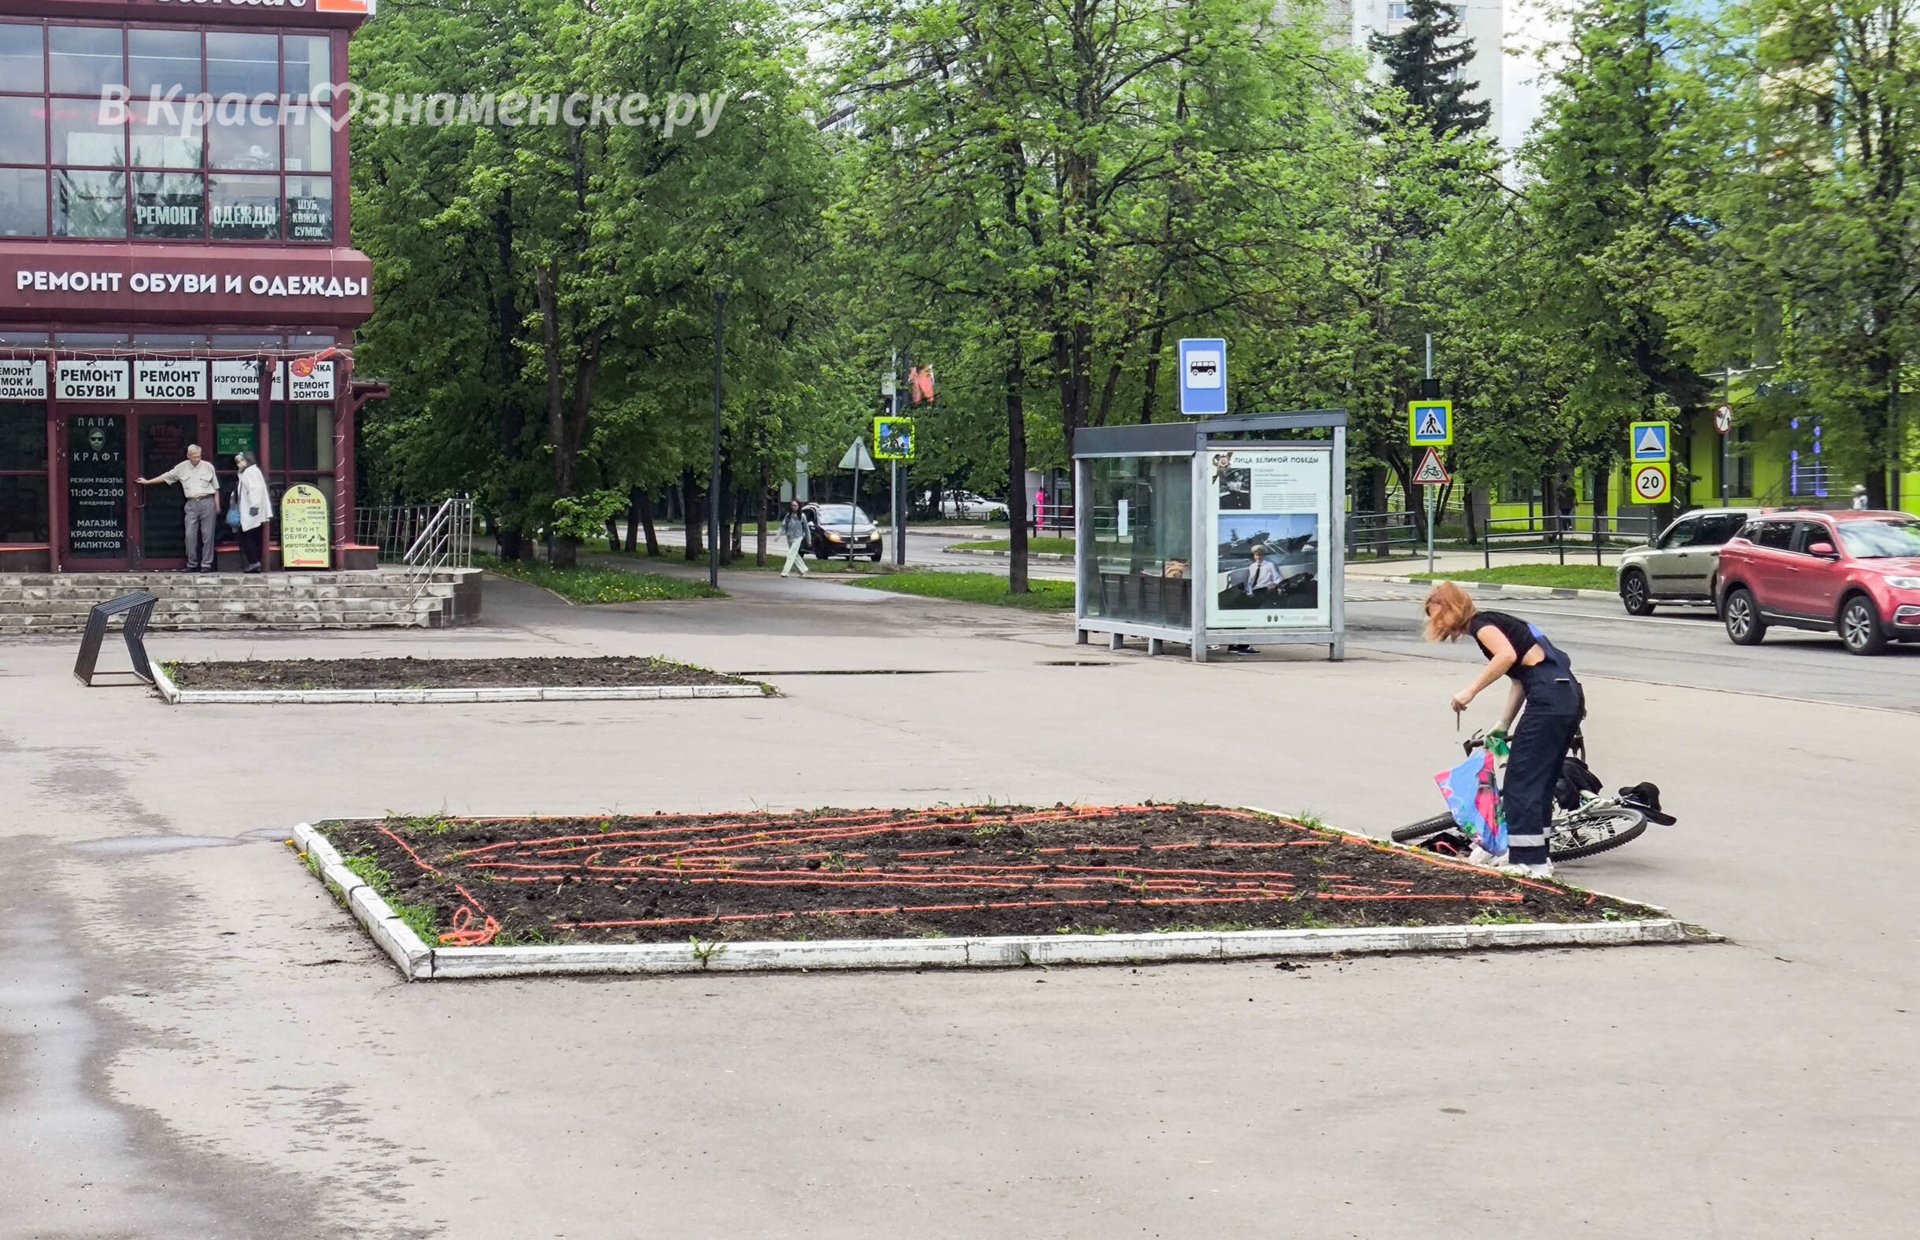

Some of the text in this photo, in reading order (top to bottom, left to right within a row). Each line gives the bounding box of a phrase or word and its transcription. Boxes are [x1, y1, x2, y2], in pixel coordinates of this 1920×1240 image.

[136, 205, 276, 228] РЕМОНТ ОДЕЖДЫ
[292, 213, 325, 224] КОЖИ И
[294, 226, 323, 237] СУМОК
[17, 270, 368, 298] РЕМОНТ ОБУВИ И ОДЕЖДЫ
[0, 367, 31, 376] МОНТ
[60, 369, 123, 382] РЕМОНТ
[140, 370, 200, 382] РЕМОНТ
[0, 377, 33, 386] МОК И
[214, 375, 281, 383] ИЗГОТОВЛИЕ
[293, 381, 330, 389] РЕМОНТ
[0, 387, 45, 397] ОДАНОВ
[65, 384, 116, 397] ОБУВИ
[145, 385, 195, 398] ЧАСОВ
[293, 390, 330, 398] ЗОНТОВ
[77, 418, 114, 427] ПАПА
[73, 452, 119, 461] КРАФТ
[1642, 476, 1659, 489] 20
[70, 488, 124, 497] 11:00-23:00
[77, 519, 117, 527] МАГАЗИН
[70, 530, 124, 538] КРАФТОВЫХ
[74, 541, 120, 549] НАПИТКОВ
